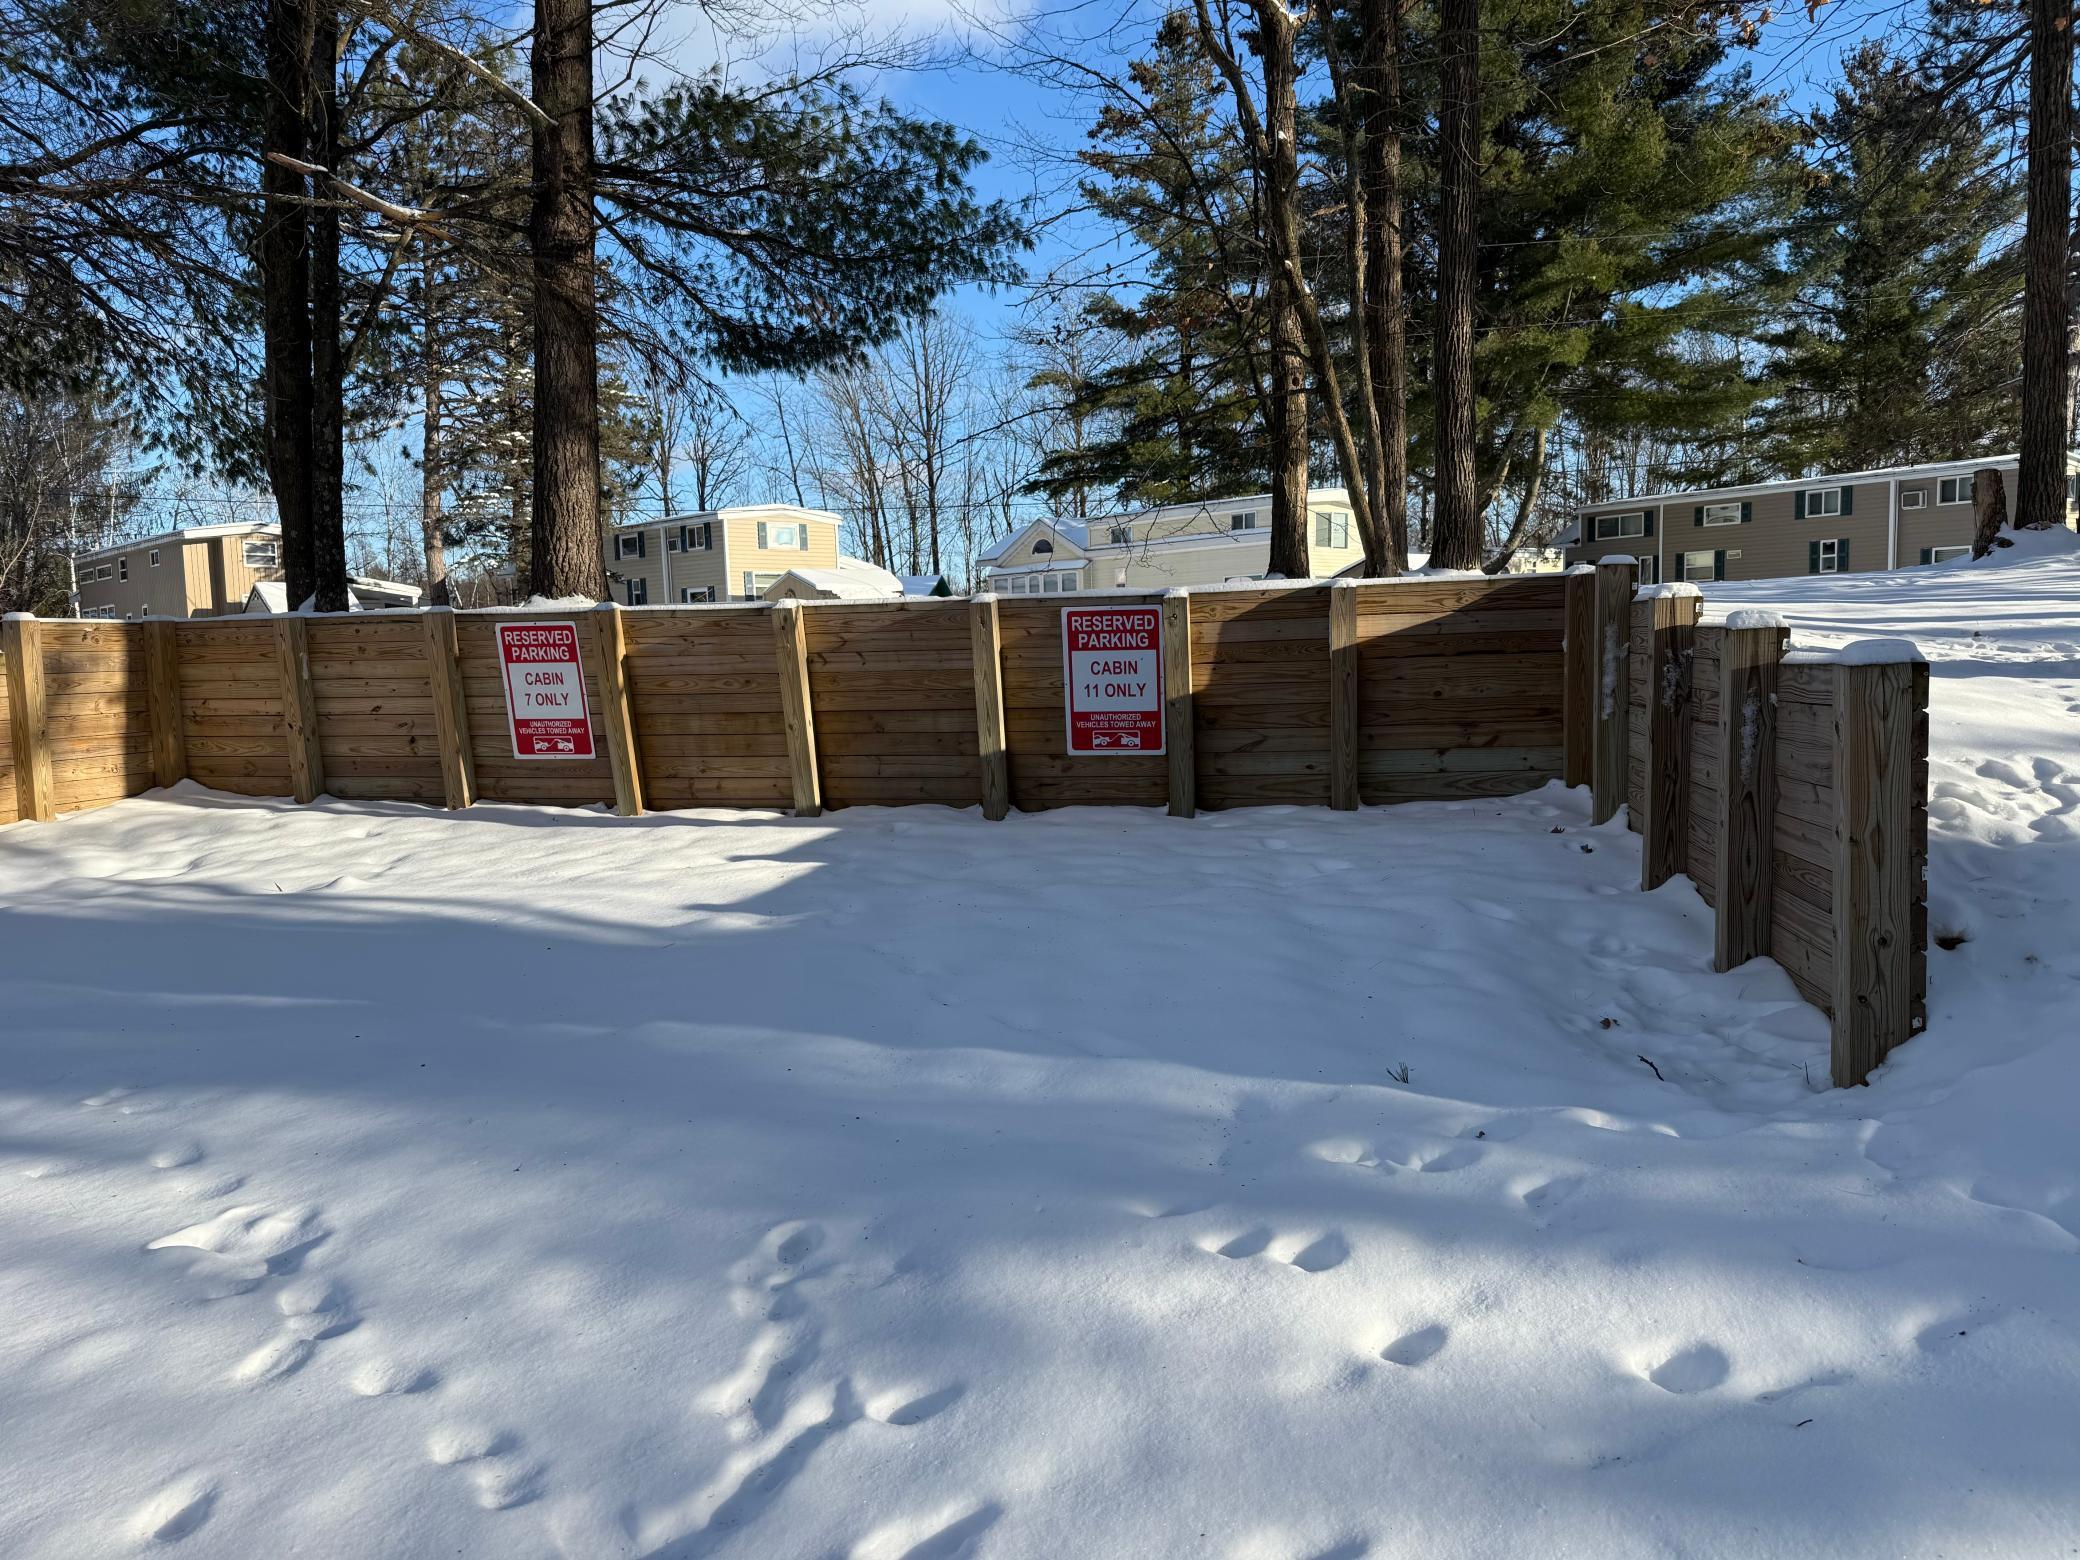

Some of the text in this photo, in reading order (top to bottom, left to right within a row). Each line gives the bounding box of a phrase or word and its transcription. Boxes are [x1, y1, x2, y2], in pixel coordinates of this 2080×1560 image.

[1072, 615, 1154, 631] RESERVED
[505, 631, 572, 645] RESERVED
[1078, 633, 1148, 648] PARKING
[512, 647, 569, 660] PARKING
[1090, 661, 1137, 675] CABIN
[525, 672, 564, 685] CABIN
[1084, 683, 1146, 697] 11 ONLY
[525, 693, 569, 706] 7 ONLY
